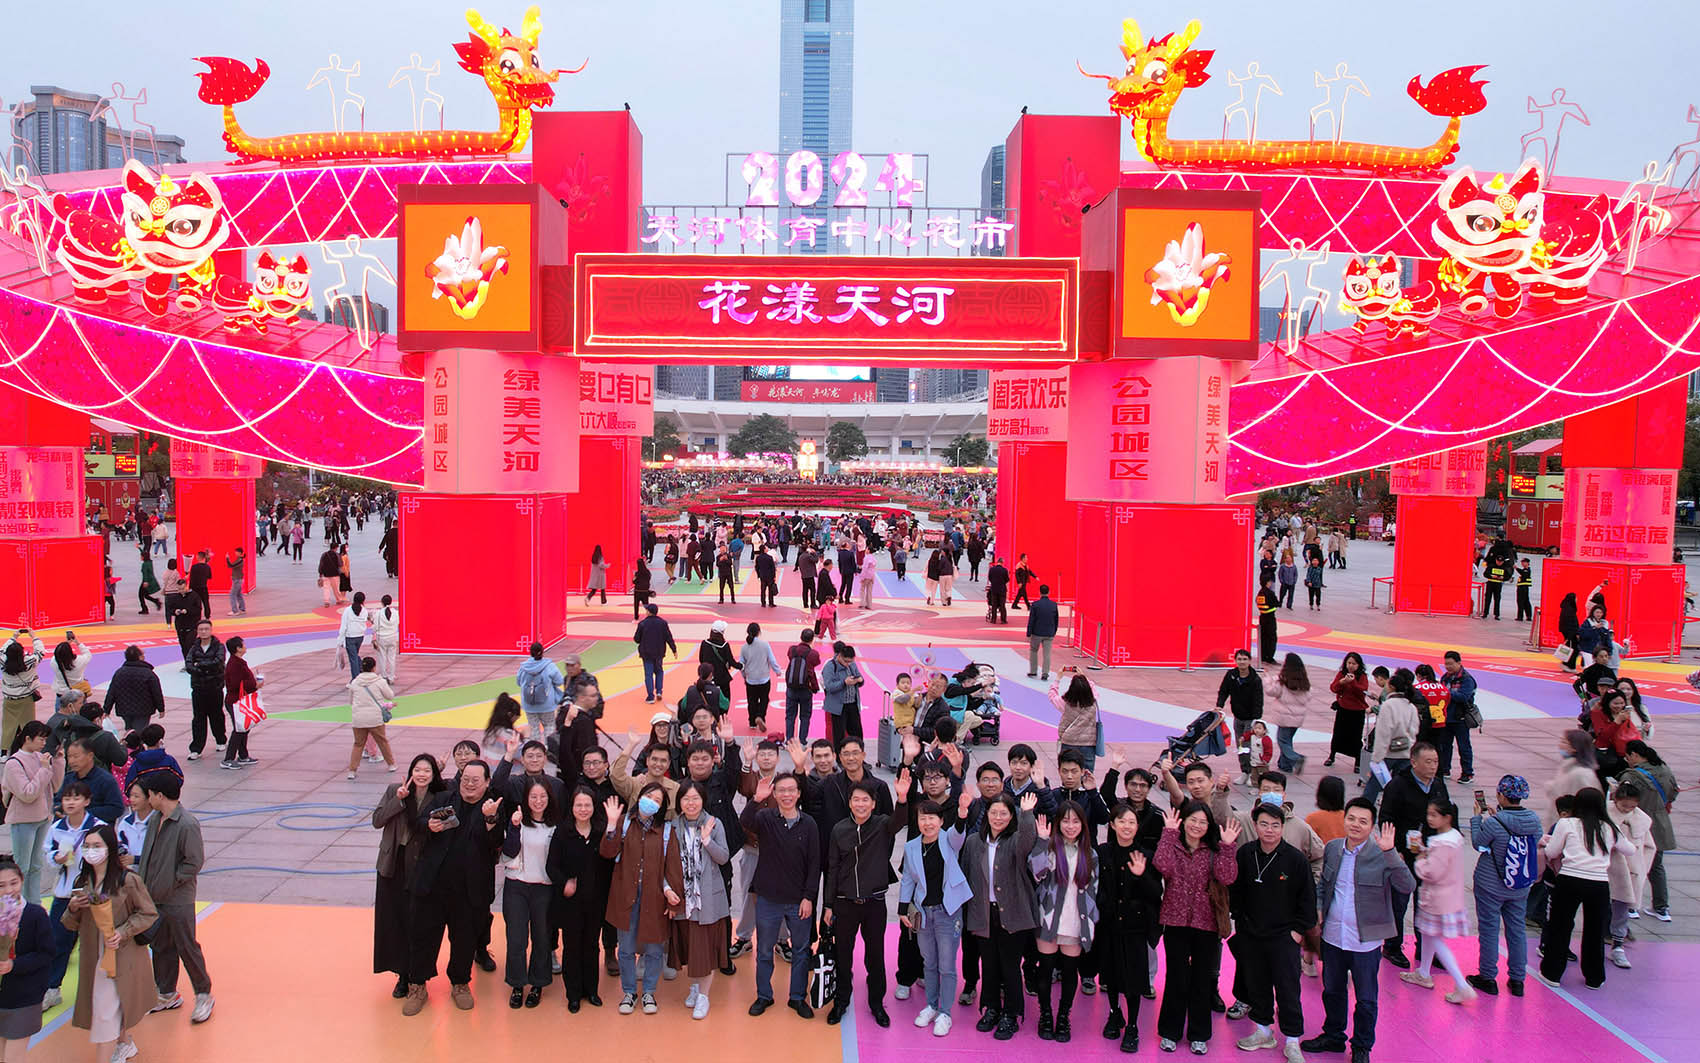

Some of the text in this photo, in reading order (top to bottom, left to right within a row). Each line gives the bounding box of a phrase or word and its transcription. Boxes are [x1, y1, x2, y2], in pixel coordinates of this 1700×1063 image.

[741, 150, 924, 208] 2024
[640, 215, 1015, 249] 天河体育中心花市
[698, 281, 955, 327] 花漾天河
[433, 367, 448, 473] 公园城区
[503, 369, 541, 473] 绿美天河
[993, 377, 1067, 410] 阖家欢乐
[989, 418, 1030, 436] 步步高升
[1110, 376, 1152, 480] 公园城区
[1205, 376, 1221, 482] 绿美天河
